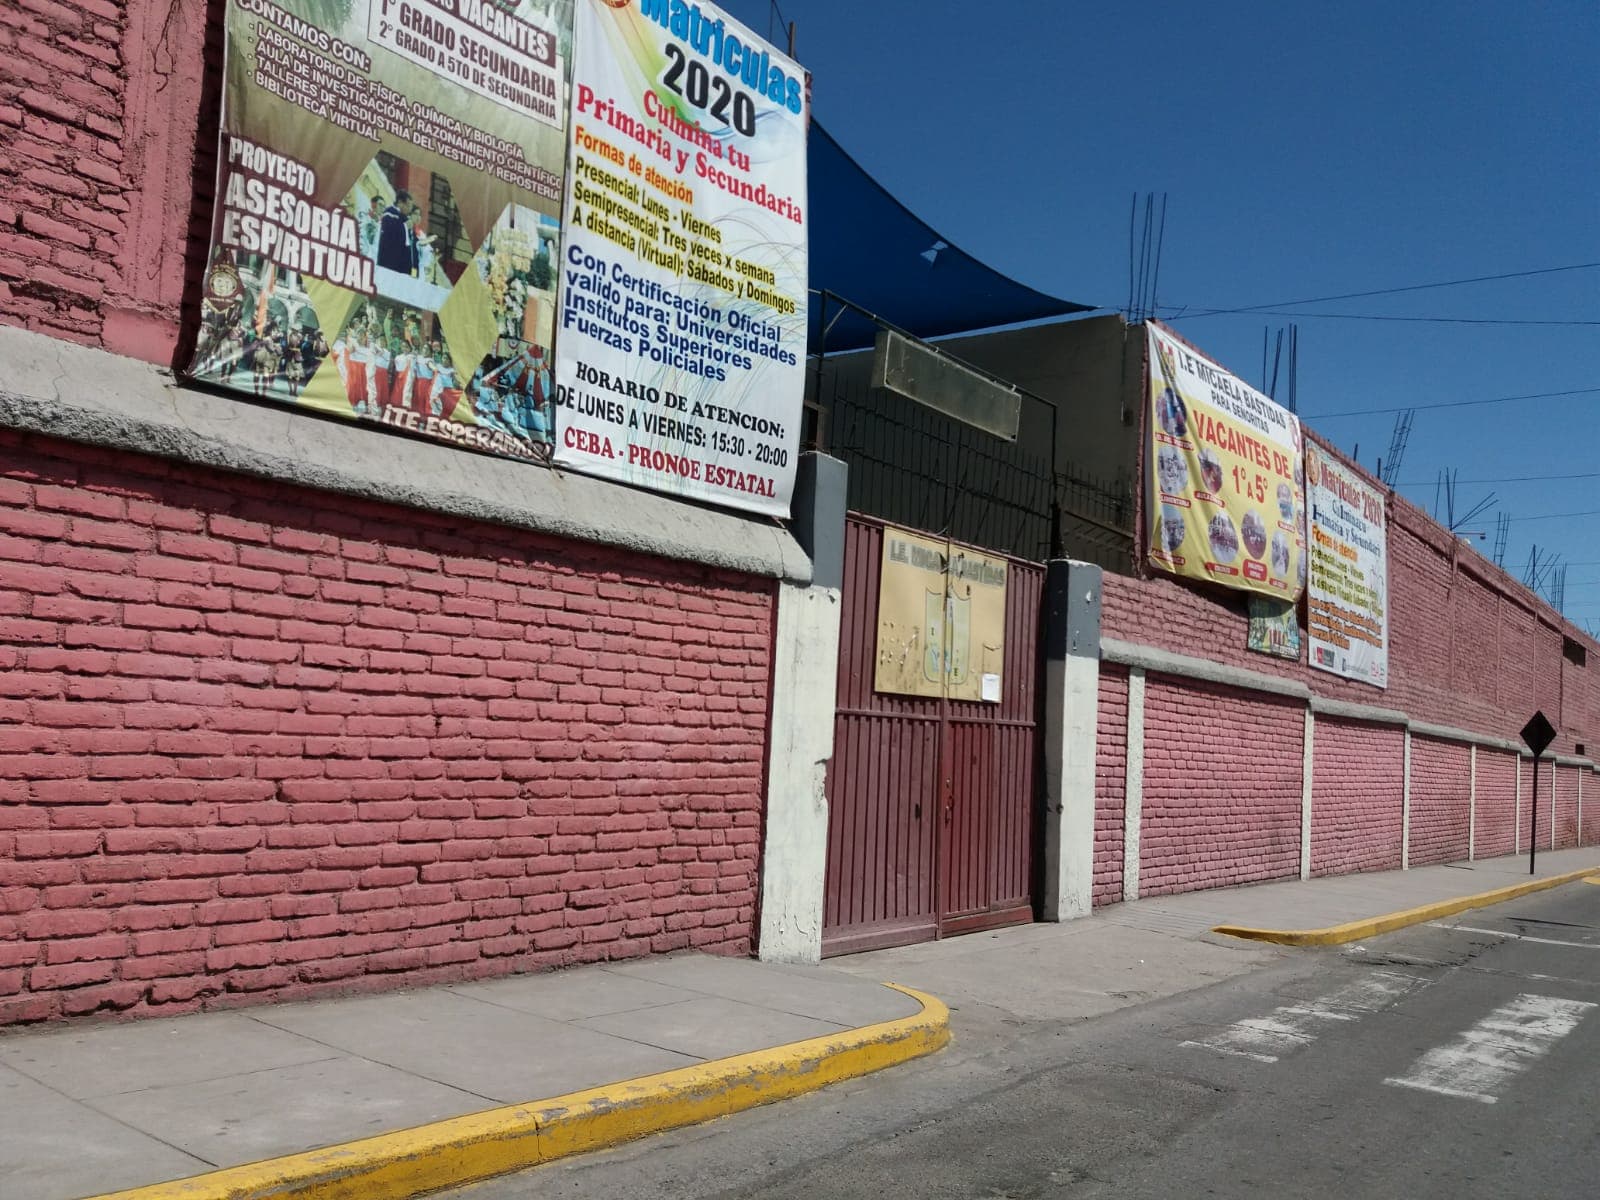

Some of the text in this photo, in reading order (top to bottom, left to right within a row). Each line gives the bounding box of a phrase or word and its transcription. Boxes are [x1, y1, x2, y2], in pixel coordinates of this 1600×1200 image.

[239, 0, 370, 71] CONTAMOS CON:
[400, 3, 455, 51] GRADO
[460, 35, 556, 99] SECUNDARIA
[459, 0, 549, 60] VACANTES
[256, 72, 381, 142] BIBLIOTECA VIRTUAL
[256, 56, 318, 96] TALLERES
[320, 89, 336, 106] DE
[412, 132, 435, 151] DEL
[436, 143, 484, 170] VESTIDO
[487, 163, 495, 175] Y
[257, 41, 291, 68] AULA
[293, 60, 310, 77] DE
[312, 69, 405, 122] INVESTIGACIÓN
[407, 114, 417, 126] Y
[417, 119, 505, 165] RAZONAMIENTO
[258, 23, 345, 79] LABORATORIO
[347, 71, 367, 90] DE:
[413, 102, 461, 132] QUÍMICA
[464, 124, 473, 136] Y
[473, 128, 524, 159] BIOLOGÍA
[396, 29, 435, 62] GRADO
[437, 51, 445, 68] A
[448, 56, 469, 80] 5TO
[473, 69, 485, 88] DE
[488, 76, 556, 120] SECUNDARIA
[663, 43, 756, 137] 2020
[229, 136, 315, 196] PROYECTO
[575, 125, 693, 206] Formas de atención
[576, 84, 803, 225] Primaria y Secundaria
[643, 89, 750, 172] Culmina tu
[224, 171, 357, 253] ASESORÍA
[574, 181, 775, 285] Semipresencial: Tres veces x semana
[575, 156, 640, 204] Presencial:
[641, 189, 669, 223] Lunes
[680, 209, 722, 244] Viernes
[222, 210, 375, 294] ESPIRITUAL
[567, 244, 782, 343] Con Certificación Oficial
[572, 205, 795, 315] A distancia (Virtual): Sábados y Domingos
[563, 309, 726, 382] Fuerzas Policiales
[565, 287, 753, 370] Institutos Superiores
[566, 270, 797, 367] valido para: Universidades
[556, 384, 575, 410] DE
[577, 391, 624, 426] LUNES
[628, 408, 638, 430] A
[643, 411, 707, 448] VIERNES:
[711, 430, 745, 457] 15:30
[755, 441, 788, 469] 20:00
[576, 361, 785, 440] HORARIO DE ATENCION:
[1196, 360, 1243, 402] MICAELA
[1243, 388, 1286, 429] BASTIDAS
[1211, 389, 1231, 412] PARA
[563, 426, 615, 459] CEBA
[628, 443, 701, 481] PRONOE
[704, 464, 777, 498] ESTATAL
[1193, 409, 1292, 479] VACANTES DE
[1247, 481, 1254, 499] A
